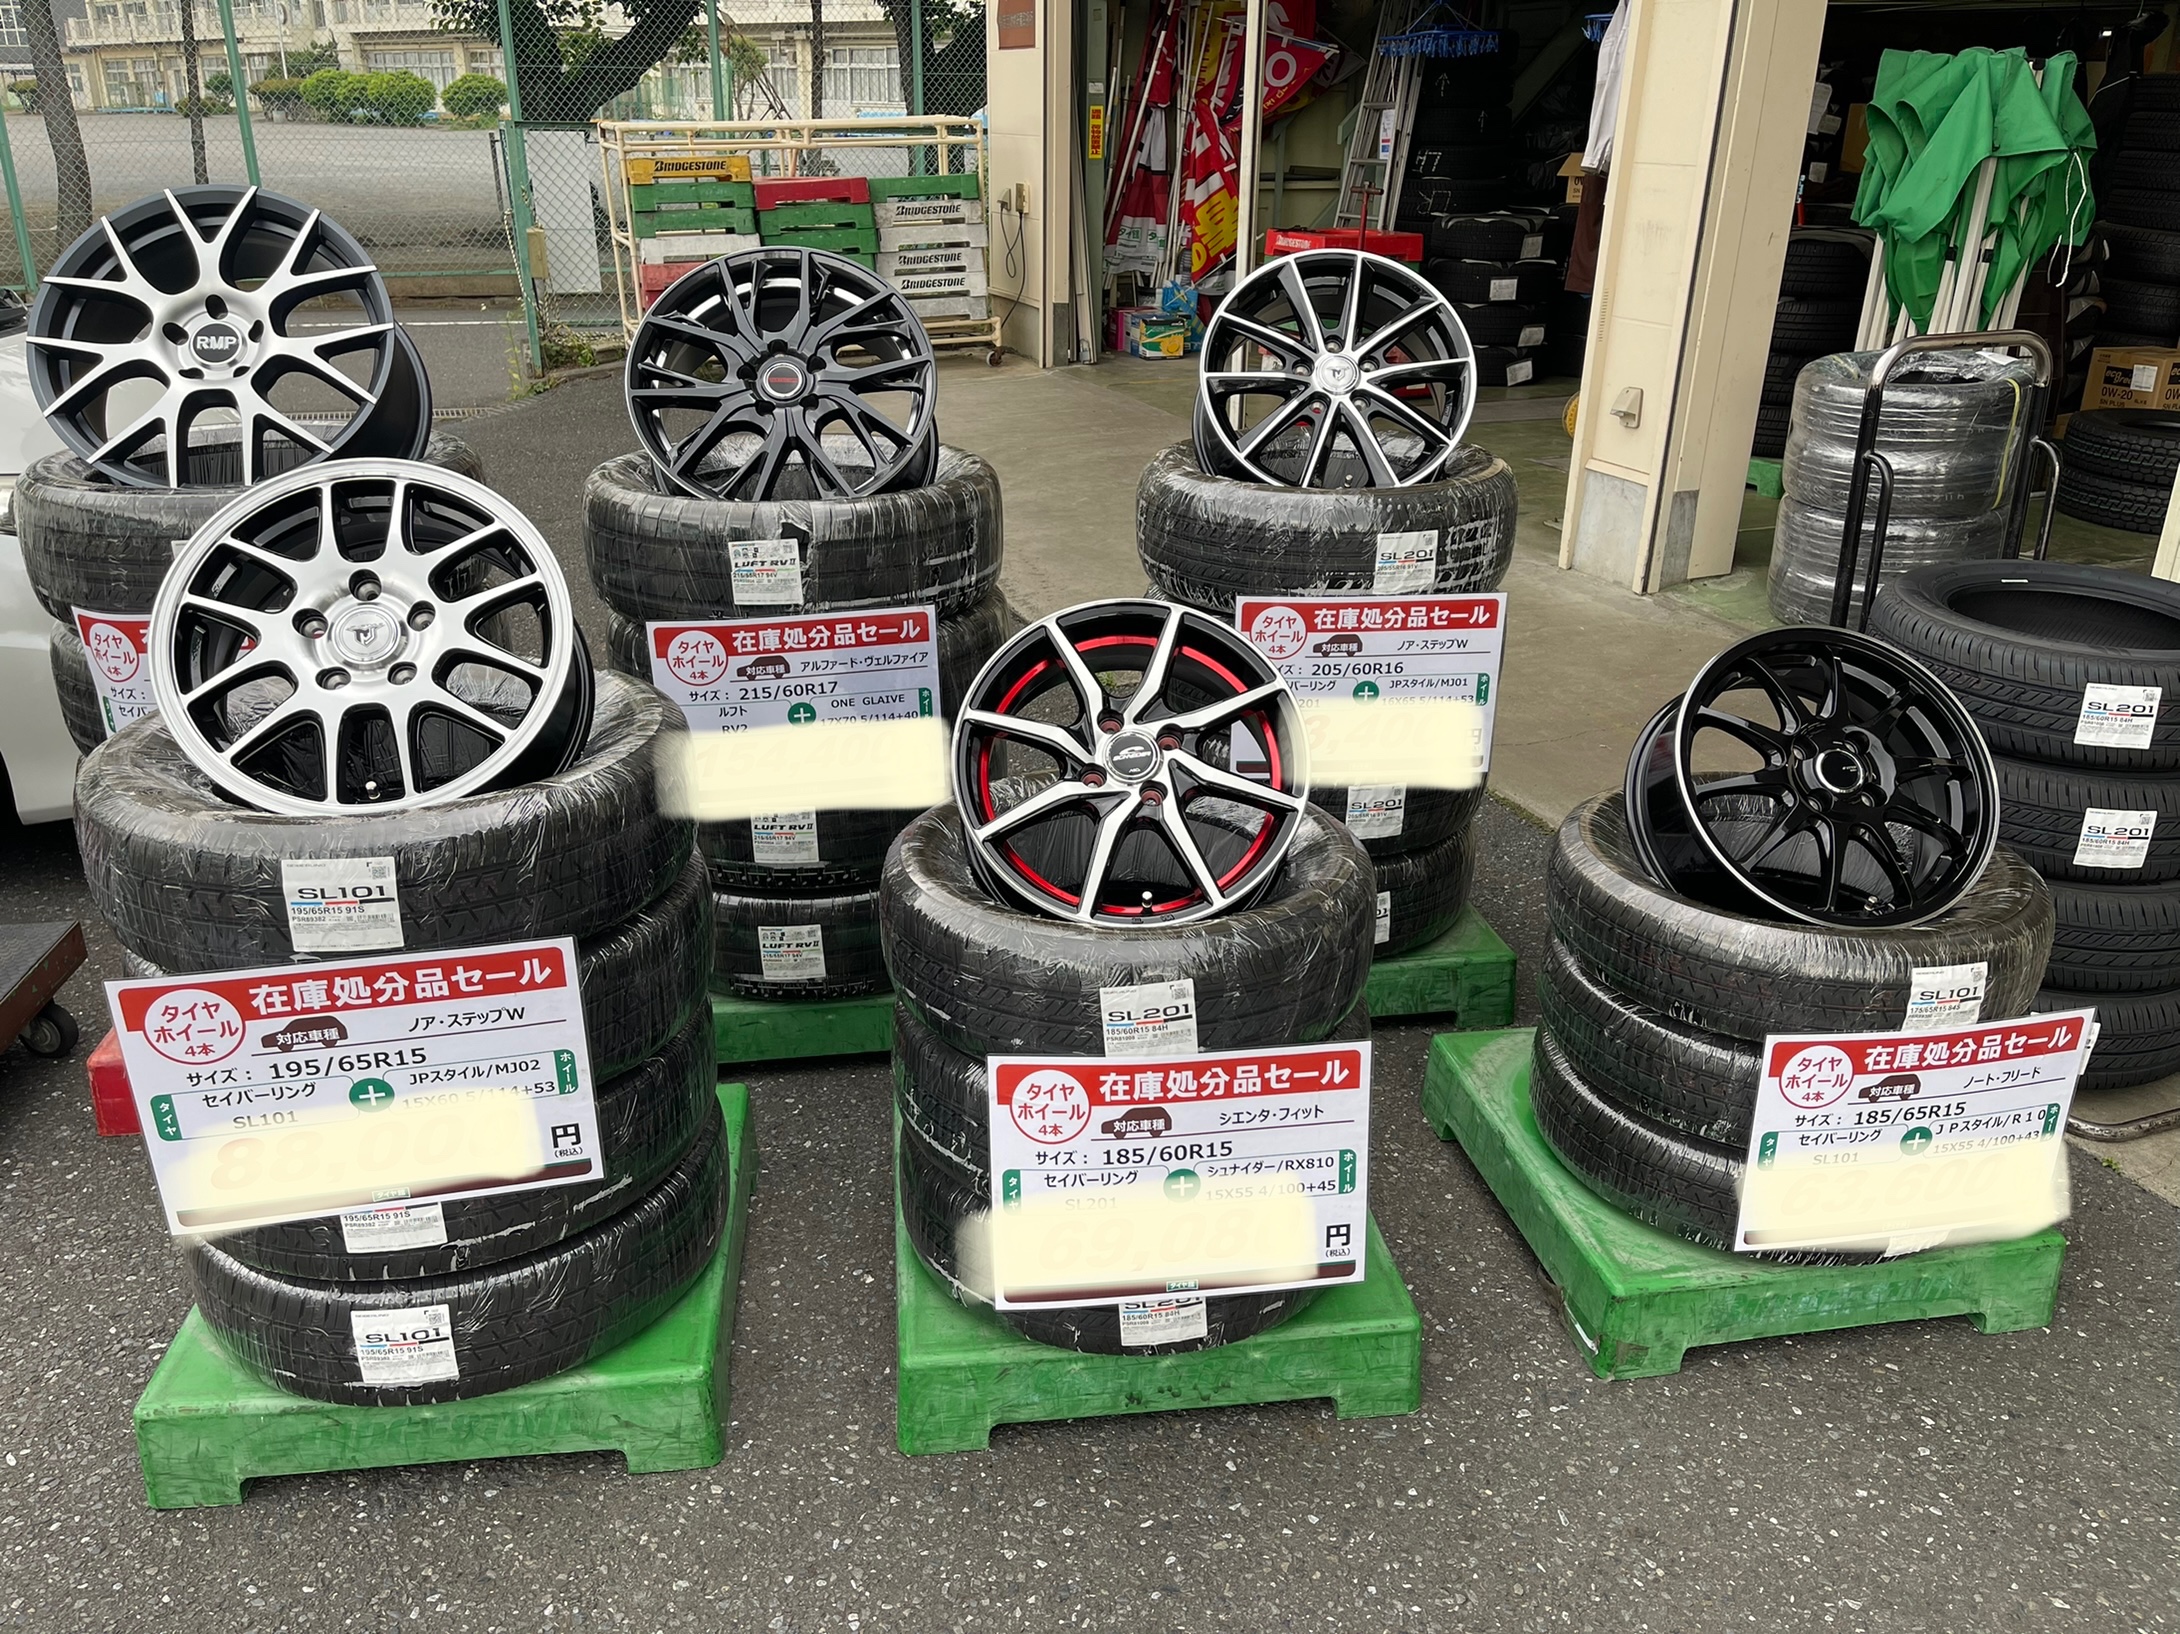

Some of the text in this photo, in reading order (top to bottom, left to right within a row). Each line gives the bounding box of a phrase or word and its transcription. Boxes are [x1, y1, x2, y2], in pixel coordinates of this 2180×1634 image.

[654, 160, 727, 172] BRIDGESTONE
[895, 204, 962, 216] BRIDGESTONE
[898, 252, 962, 266] BRIDGESTONE
[900, 277, 966, 290] BRIDGESTONE
[196, 335, 238, 350] RMP
[2101, 386, 2134, 400] 0W-20
[1380, 549, 1434, 561] SL201
[735, 560, 768, 568] LUFT
[1262, 615, 1298, 629] タイヤ
[1313, 605, 1491, 630] 在庫処分品セール
[94, 632, 123, 650] タイヤ
[732, 618, 921, 653] 在庫処分品セール
[1255, 629, 1303, 643] ホイール
[677, 640, 715, 654] タイヤ
[1268, 645, 1287, 654] 4本
[1321, 642, 1359, 653] 対応車種
[1397, 638, 1469, 651] ノア・ステップW
[94, 647, 135, 665] ホイール
[672, 655, 724, 669] ホイール
[107, 665, 123, 677] 4本
[689, 670, 709, 680] 4本
[745, 664, 787, 676] 対応車種
[1278, 661, 1404, 677] イズ： 205/60R16
[739, 681, 838, 701] 215/60R17
[1287, 680, 1337, 691] バーリング
[1478, 675, 1489, 706] ホイール
[831, 693, 906, 709] ONE GLAIVE
[1298, 698, 1320, 709] 201
[1420, 694, 1474, 705] 5/114+53
[118, 704, 151, 718] セイバ
[719, 705, 748, 718] ルフト
[2087, 701, 2154, 714] SL201
[821, 710, 919, 727] 17X70 5/114+40
[2082, 714, 2118, 723] 185/60R15
[721, 724, 748, 734] RV2
[1351, 799, 1403, 810] SL201
[754, 823, 786, 831] LUFT
[2087, 825, 2150, 837] SL201
[2082, 837, 2115, 845] 185/60R15
[298, 885, 386, 900] SL101
[291, 905, 365, 916] 195/65R15 91S
[249, 957, 552, 1016] 在庫処分品セール
[1919, 986, 1979, 1001] SL101
[161, 1001, 221, 1023] タイヤ
[1107, 1003, 1190, 1022] SL201
[1910, 1006, 1947, 1014] 175/65R15
[408, 1006, 526, 1033] ノア・ステップW
[153, 1020, 240, 1044] ホイール
[276, 1027, 341, 1045] 対応車種
[1106, 1024, 1169, 1036] 185/60R15 84H
[184, 1043, 216, 1057] 4本
[1864, 1025, 2073, 1072] 在庫処分品セール
[269, 1047, 428, 1080] 195/65R15
[1797, 1056, 1843, 1073] タイヤ
[409, 1059, 541, 1086] JPスタイル/MJ02
[560, 1051, 576, 1094] ホイール
[1963, 1066, 2042, 1089] ノート・フリード
[1099, 1059, 1350, 1103] 在庫処分品セール
[1785, 1073, 1849, 1090] ホイール
[202, 1081, 317, 1109] セイバーリング
[1026, 1082, 1075, 1102] タイヤ
[1801, 1091, 1825, 1102] 4本
[1869, 1083, 1916, 1097] 対応車種
[159, 1101, 178, 1137] タイヤ
[1017, 1103, 1086, 1121] ホイール
[1218, 1104, 1325, 1126] シエンタ・フィット
[1853, 1101, 1967, 1126] 185/65R15
[232, 1110, 299, 1130] SL101
[1113, 1118, 1166, 1133] 対応車種
[550, 1122, 582, 1149] 円
[1038, 1123, 1064, 1137] 4本
[1798, 1128, 1884, 1147] セイバーリング
[1933, 1130, 2040, 1154] 15X55 4/100+43
[1103, 1140, 1233, 1166] 185/60R15
[1762, 1137, 1775, 1167] タイヤ
[1812, 1152, 1859, 1166] SL101
[1207, 1156, 1335, 1178] シュナイダー/RX810
[1343, 1152, 1355, 1193] ホイール
[1043, 1169, 1139, 1188] セイバーリング
[1008, 1176, 1019, 1211] タイヤ
[1206, 1179, 1337, 1202] 15X55 4/100+45
[1064, 1197, 1118, 1212] SL201
[344, 1211, 411, 1222] 195/65R15 91S
[1325, 1223, 1351, 1248] 円
[1122, 1310, 1181, 1321] 185/60R15 84H
[365, 1327, 441, 1344] SL101
[360, 1345, 424, 1355] 195/65R15 91S
